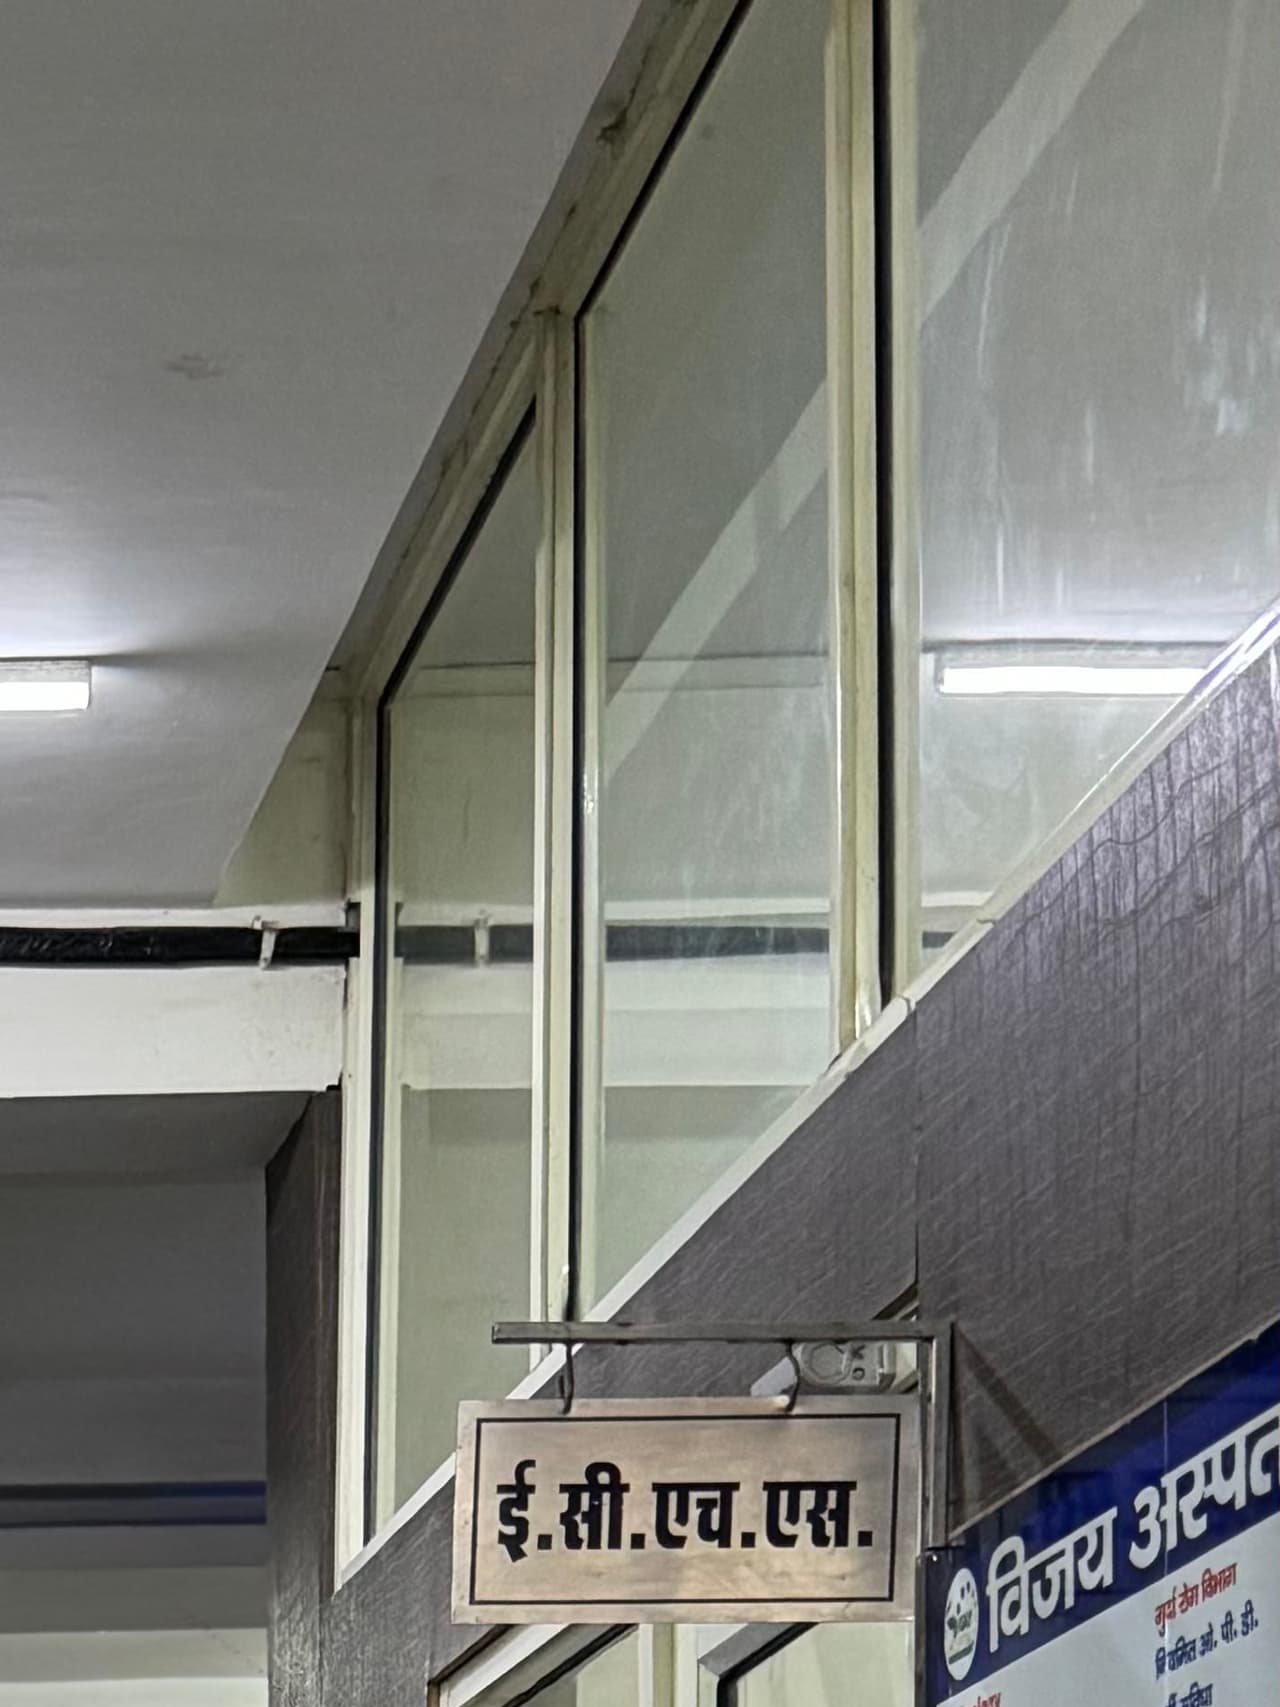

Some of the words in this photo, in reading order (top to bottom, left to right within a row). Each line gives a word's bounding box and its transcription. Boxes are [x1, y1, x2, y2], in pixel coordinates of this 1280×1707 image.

[496, 1458, 874, 1563] ई.सी.एच.एस.
[986, 1506, 1118, 1654] विजय
[1128, 1402, 1280, 1569] अस्पत
